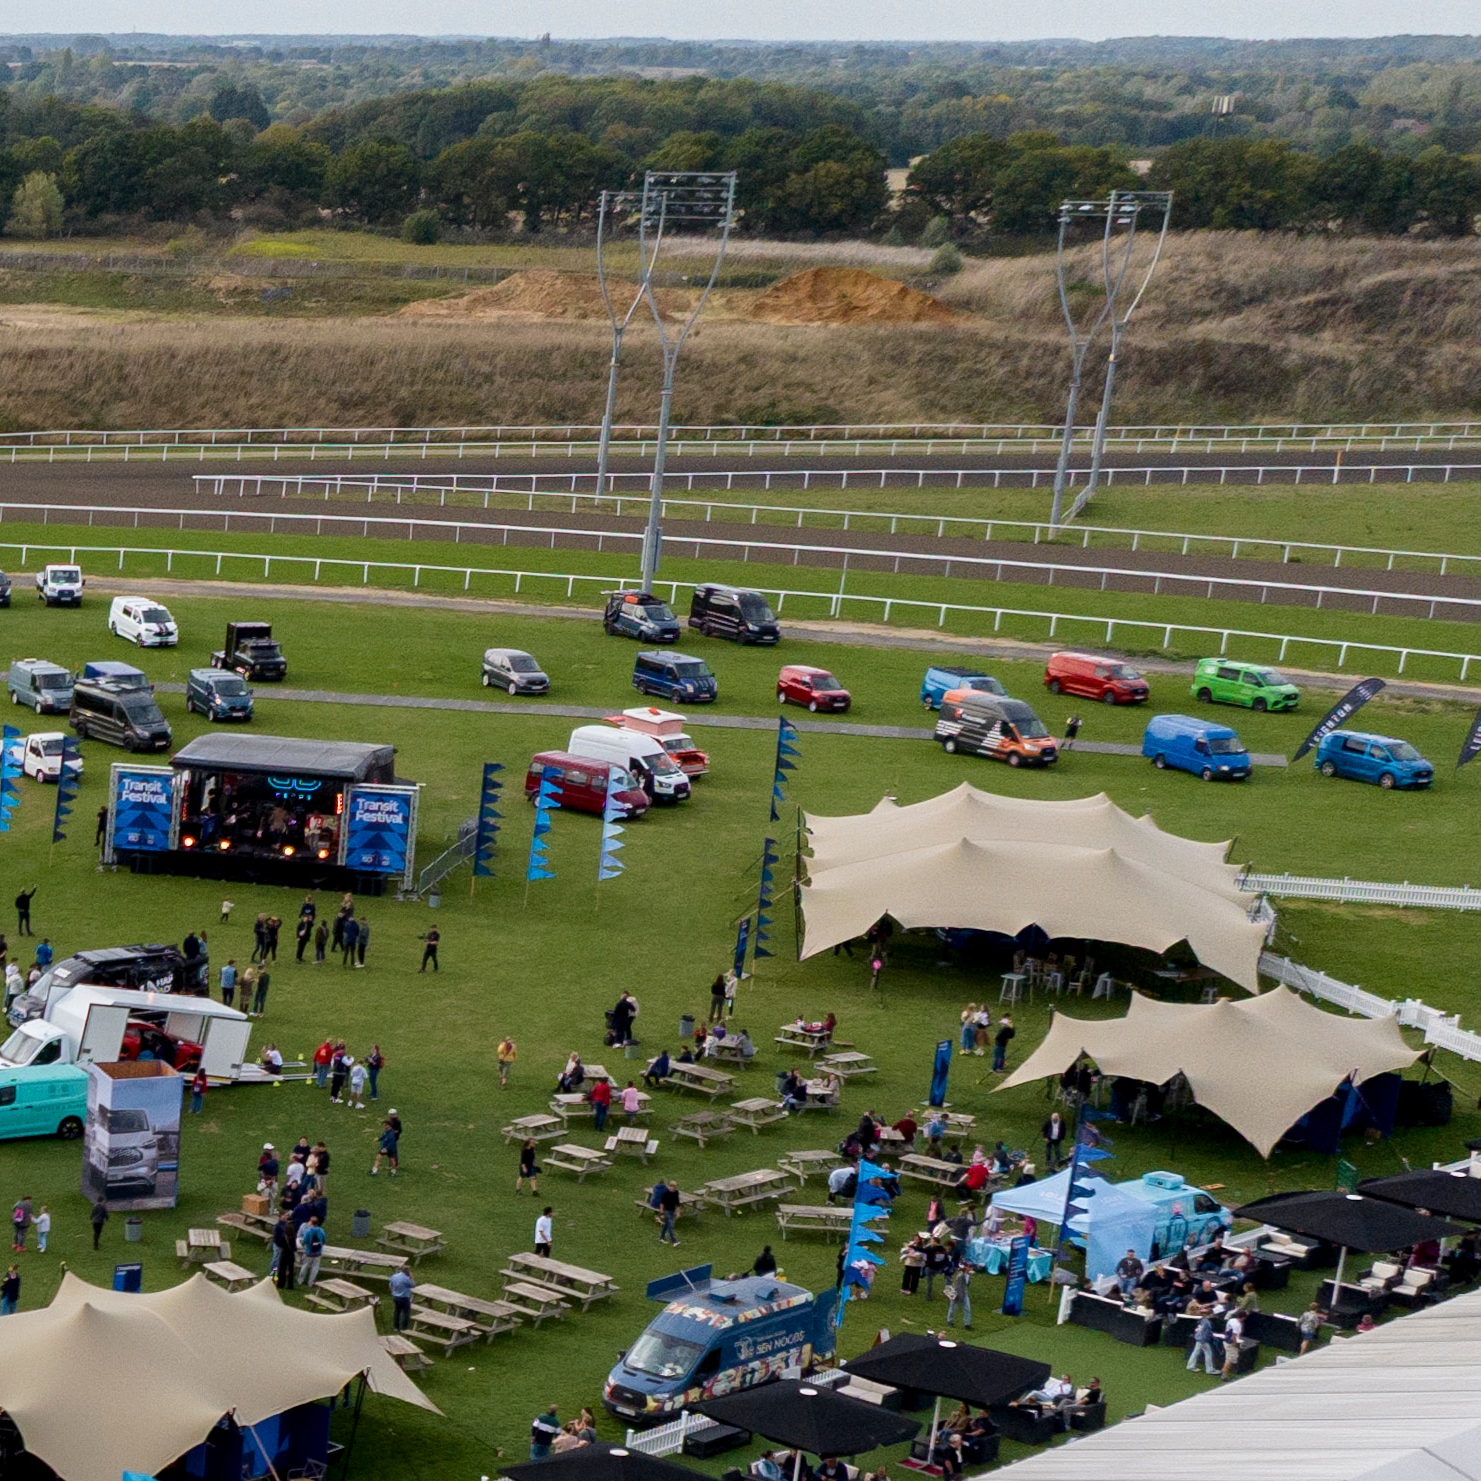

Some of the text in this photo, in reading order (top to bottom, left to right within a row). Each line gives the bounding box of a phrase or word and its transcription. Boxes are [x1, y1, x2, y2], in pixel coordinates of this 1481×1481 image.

[122, 778, 162, 794] Transit
[122, 790, 168, 805] Festival
[356, 798, 399, 812] Transit
[355, 810, 404, 825] Festival
